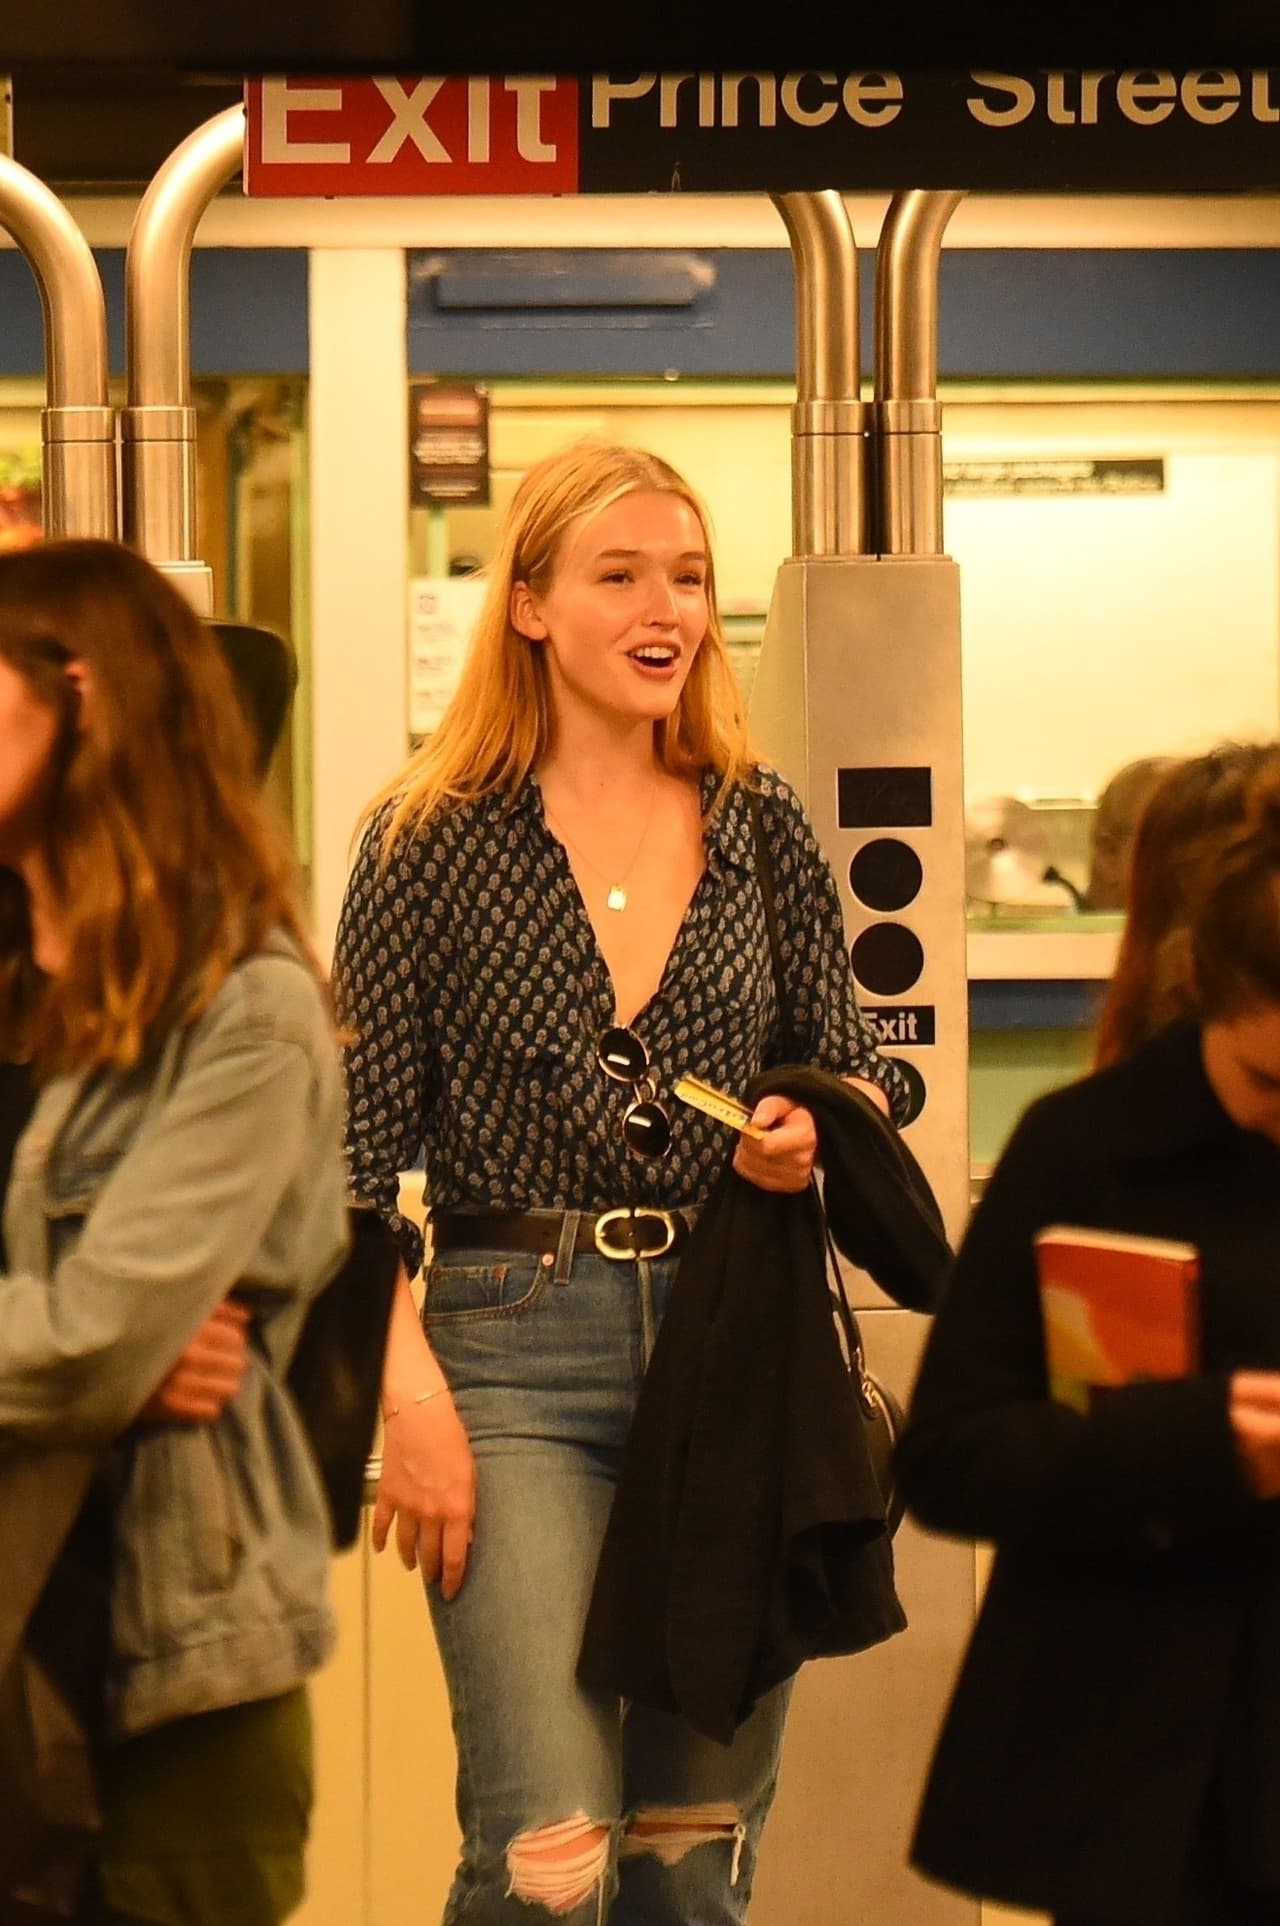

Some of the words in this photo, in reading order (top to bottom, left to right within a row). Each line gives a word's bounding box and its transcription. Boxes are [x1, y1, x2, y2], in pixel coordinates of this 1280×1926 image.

[261, 74, 557, 164] Exit
[592, 71, 904, 128] Prince
[966, 71, 1280, 127] Street
